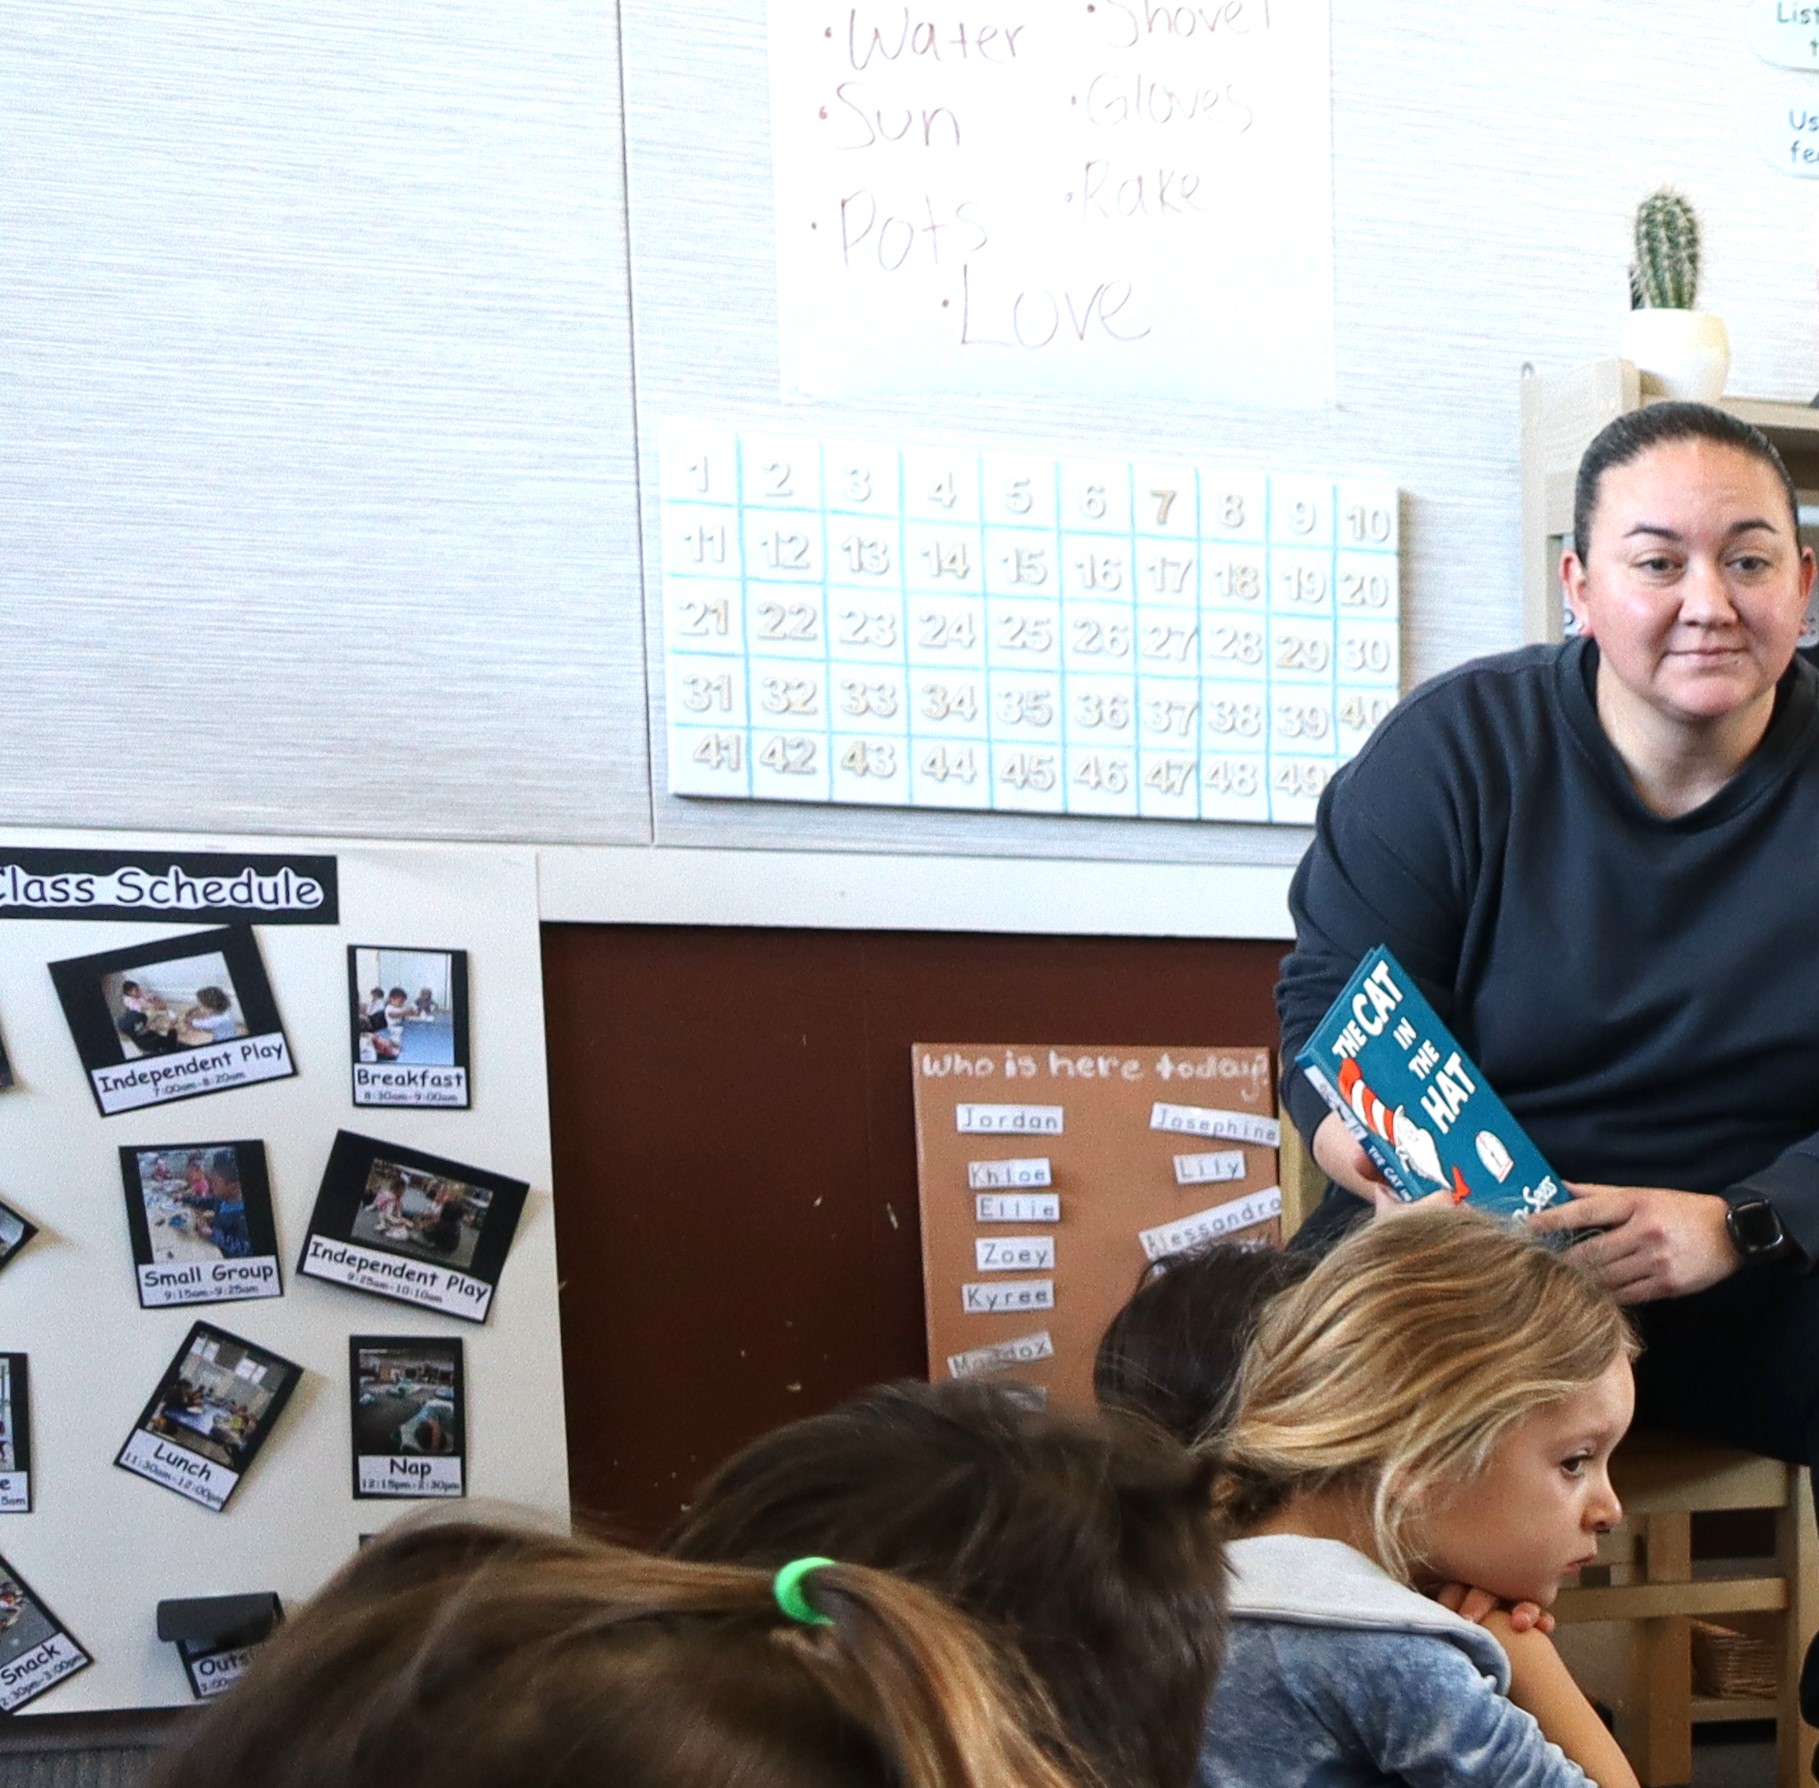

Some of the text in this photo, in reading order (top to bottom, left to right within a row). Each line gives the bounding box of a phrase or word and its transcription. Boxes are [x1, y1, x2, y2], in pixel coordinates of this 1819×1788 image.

[848, 7, 1024, 71] Water
[834, 80, 961, 150] Sun
[1086, 72, 1254, 135] Gloves
[1082, 159, 1212, 223] Rake
[839, 189, 988, 271] Pots
[961, 262, 1151, 349] Love
[688, 455, 1391, 544] 1 2 3 4 5 6 7 8 9 10
[683, 524, 1389, 608] 11 12 13 14 15 16 17 18 19 20
[678, 599, 1390, 672] 21 22 23 24 25 26 27 28 29 30
[695, 733, 740, 771] 41
[760, 735, 817, 774] 42
[840, 738, 897, 778] 43
[920, 743, 978, 783] 44
[1000, 751, 1054, 791] 45
[1074, 752, 1128, 792] 46
[1144, 755, 1198, 793] 47
[1203, 757, 1257, 795] 48
[115, 866, 321, 907] Schedule
[1332, 1020, 1368, 1059] THE
[1352, 960, 1404, 1037] CAT
[1393, 1016, 1418, 1047] IN
[99, 1043, 283, 1093] Independent Play
[357, 1068, 463, 1088] Breakfast
[923, 1053, 994, 1079] Who
[1005, 1050, 1037, 1080] is
[1049, 1051, 1144, 1080] here
[1408, 1040, 1441, 1081] THE
[1421, 1051, 1477, 1135] HAT
[962, 1107, 1058, 1130] Jordan
[1155, 1107, 1278, 1142] Josephine
[972, 1163, 1047, 1184] Khloe
[1179, 1157, 1240, 1182] Lily
[979, 1198, 1056, 1218] Ellie
[309, 1241, 489, 1303] Independent Play
[983, 1242, 1049, 1266] Zoey
[144, 1264, 274, 1288] Small Group
[966, 1287, 1048, 1309] Kyree
[153, 1442, 212, 1481] Lunch
[389, 1457, 432, 1480] Nap
[0, 1643, 61, 1686] Snack
